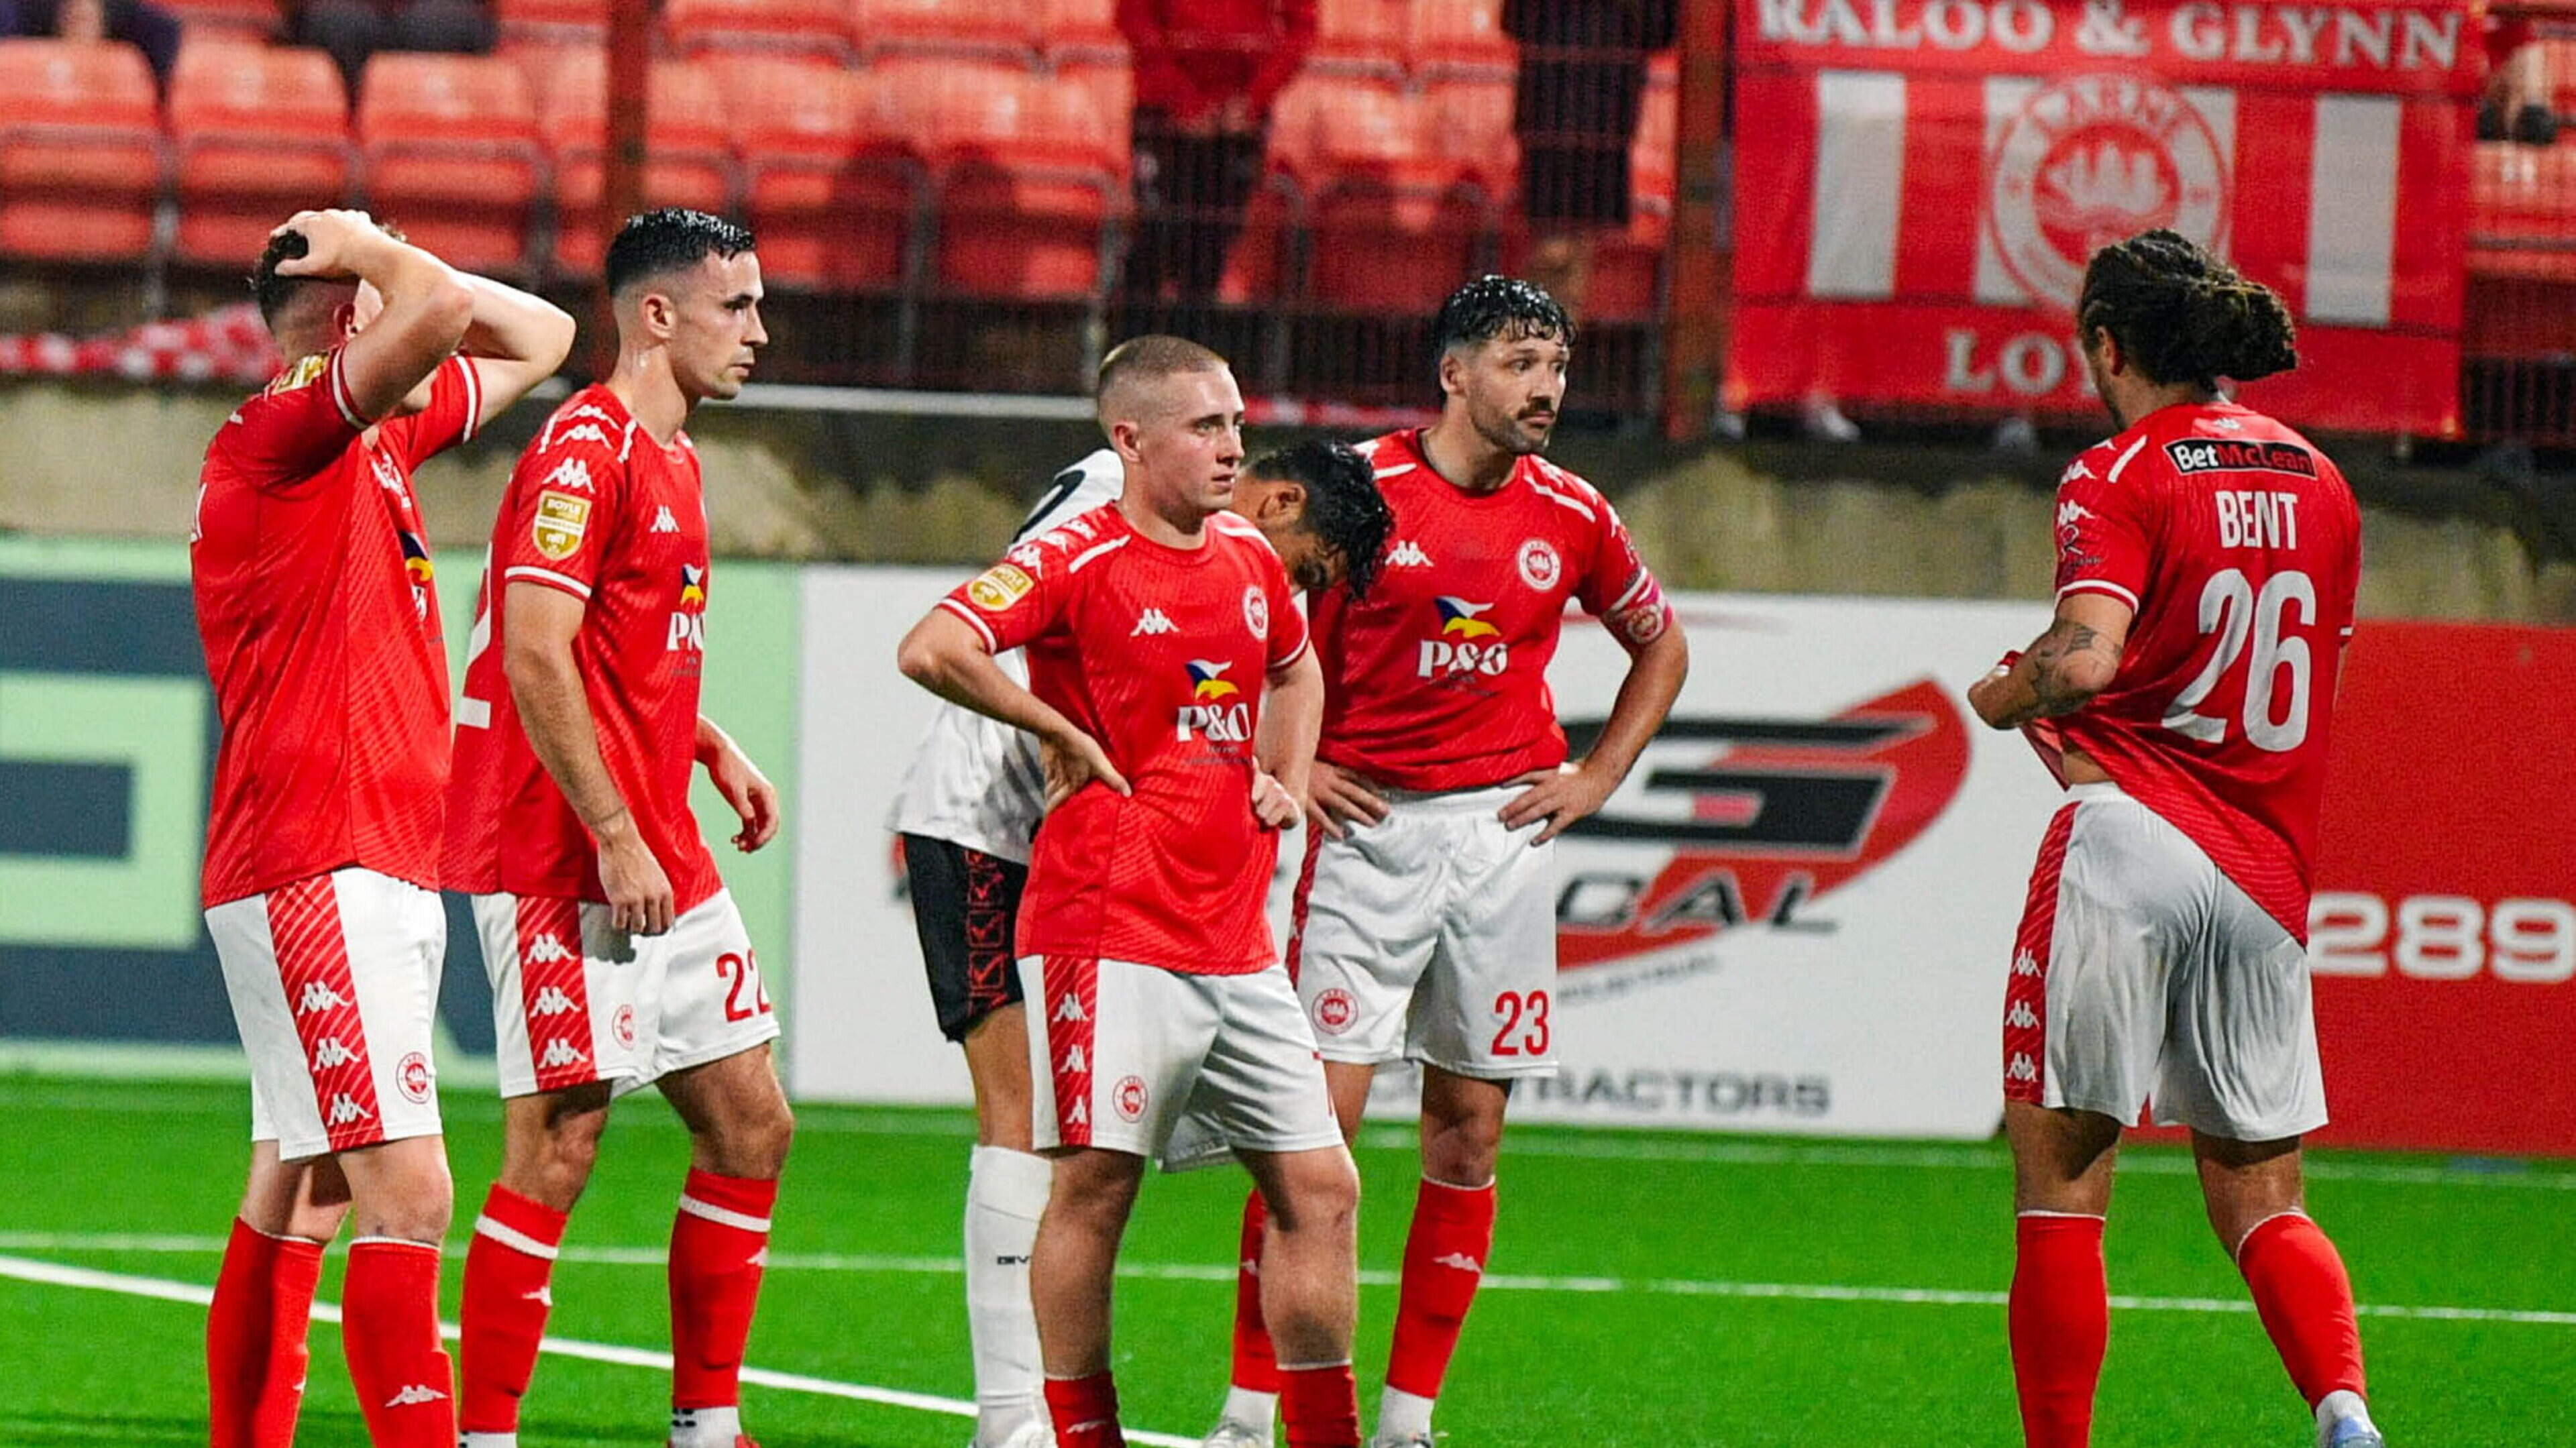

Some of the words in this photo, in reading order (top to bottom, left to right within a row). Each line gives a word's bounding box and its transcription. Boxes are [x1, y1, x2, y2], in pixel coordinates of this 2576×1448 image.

[1758, 0, 2055, 53] RALOO
[2074, 0, 2151, 56] &
[2168, 2, 2461, 69] GLYNN
[2174, 443, 2313, 474] BetMcLean
[2215, 490, 2298, 550] BENT
[1417, 638, 1509, 679] P&O
[2161, 568, 2316, 752] 26
[1177, 702, 1252, 742] P&O
[2306, 892, 2576, 984] 289
[1491, 989, 1550, 1056] 23
